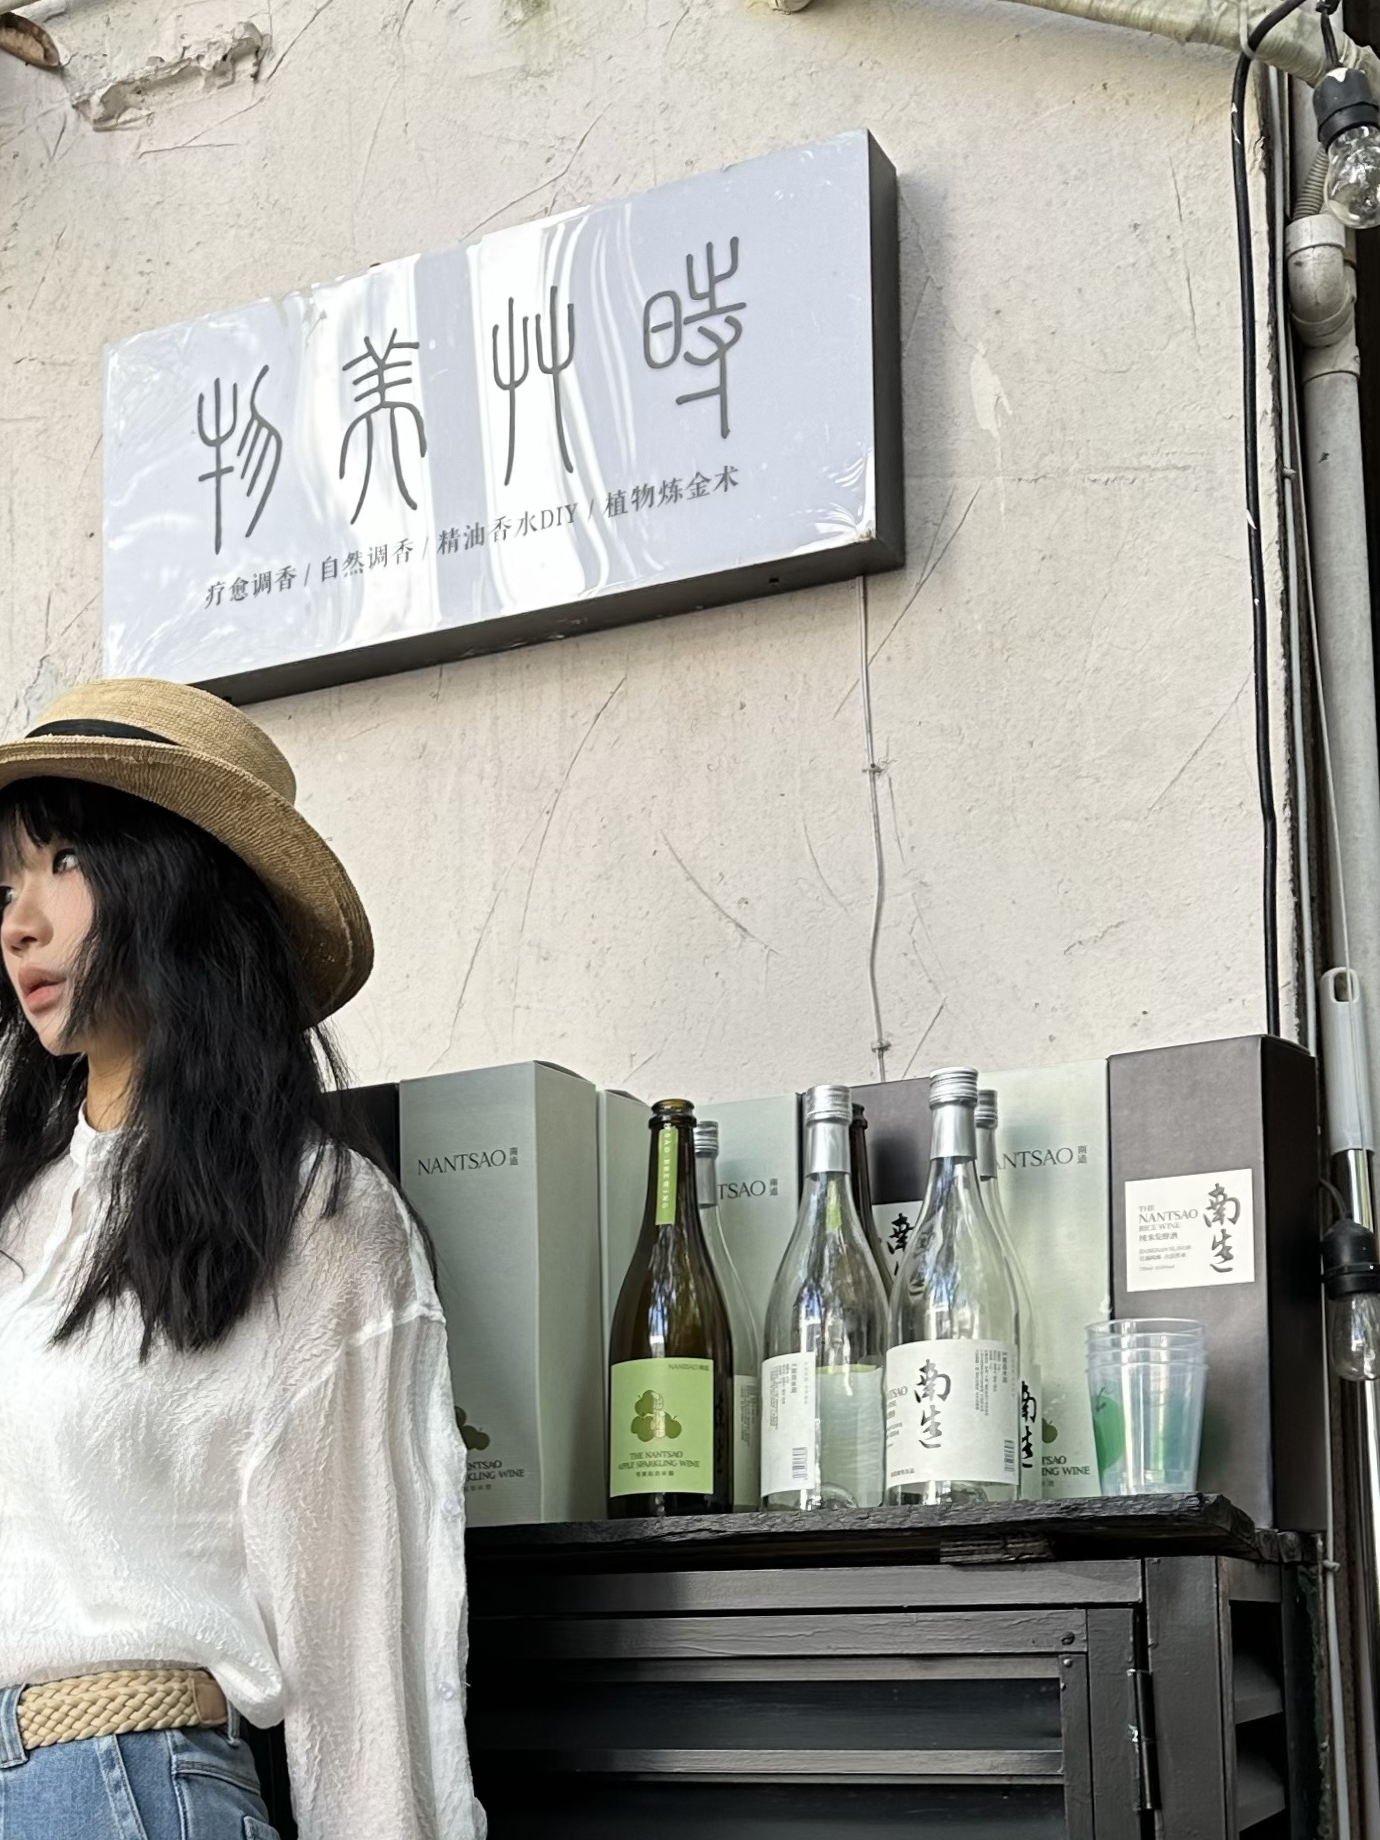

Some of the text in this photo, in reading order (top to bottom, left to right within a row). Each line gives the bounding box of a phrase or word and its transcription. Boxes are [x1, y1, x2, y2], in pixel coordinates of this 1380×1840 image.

[417, 1149, 506, 1176] NANTSAO
[997, 1147, 1074, 1170] NTSAO
[717, 1180, 766, 1200] TSAO
[1139, 1209, 1198, 1223] NANTSAO
[1062, 1466, 1091, 1475] WINE
